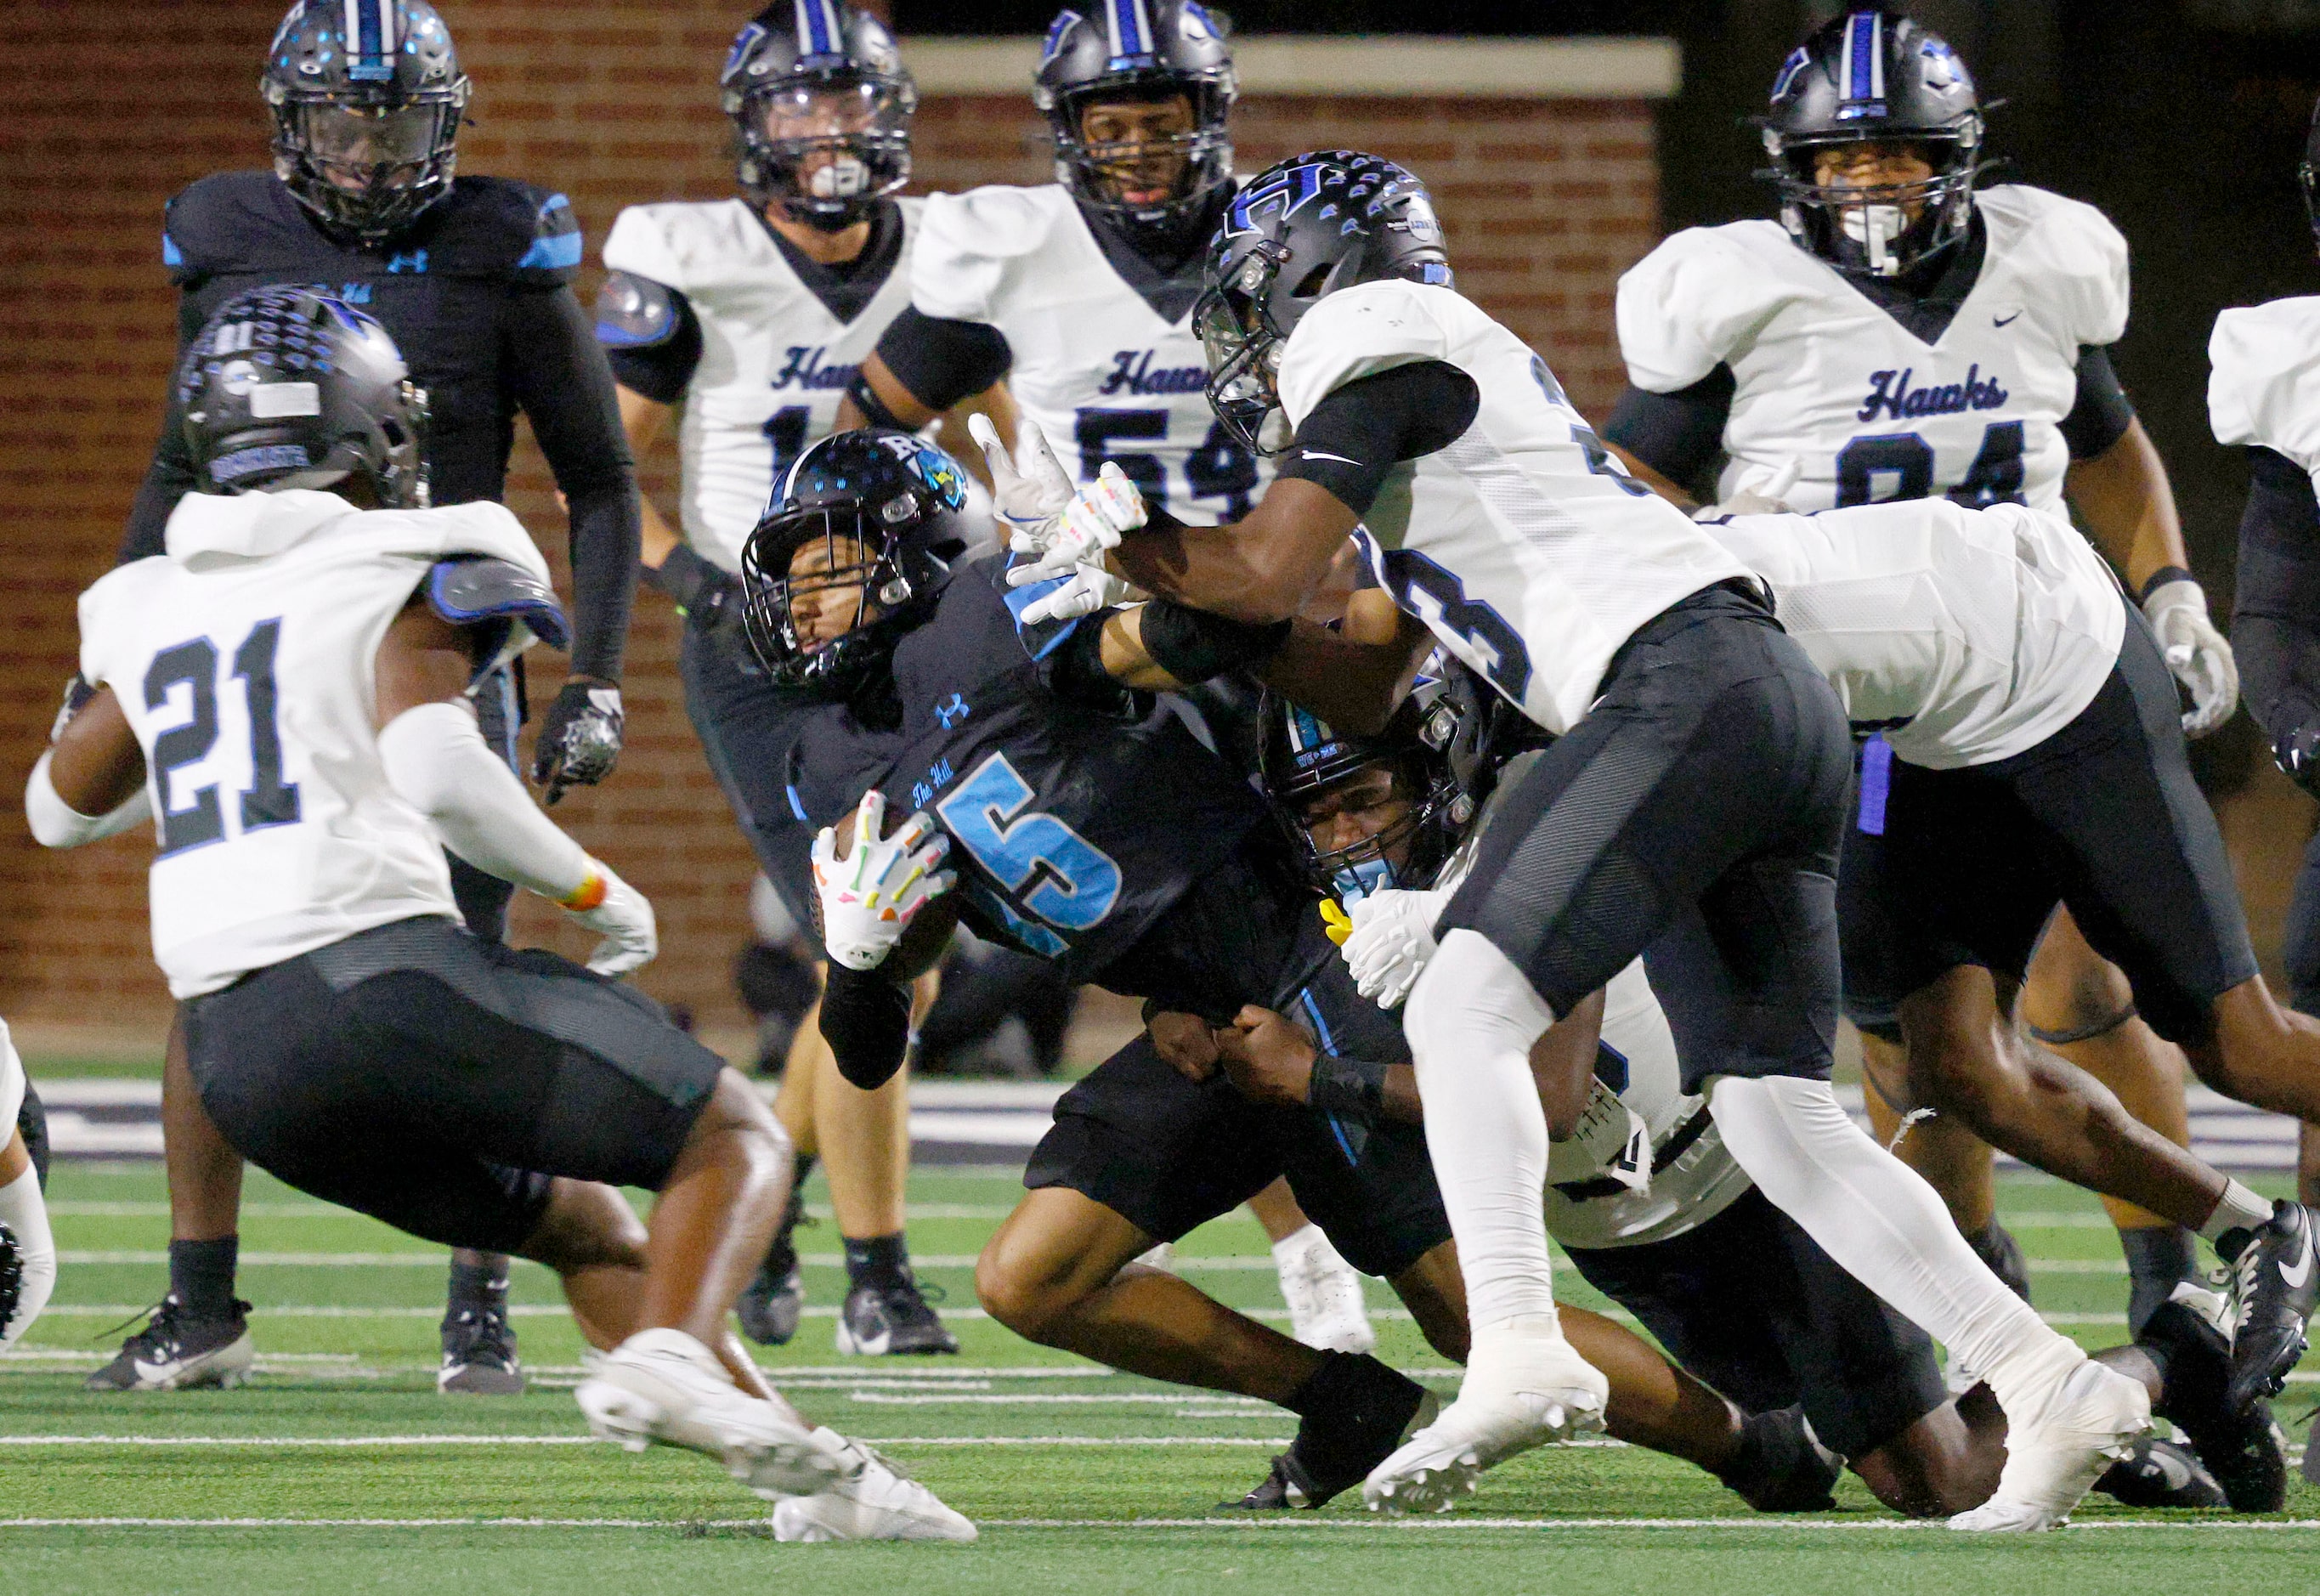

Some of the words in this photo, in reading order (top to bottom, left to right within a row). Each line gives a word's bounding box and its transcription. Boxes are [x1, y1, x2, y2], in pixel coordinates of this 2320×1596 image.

[1856, 363, 2009, 422] Hawks
[1074, 407, 1261, 524] 54
[142, 615, 303, 862] 21
[912, 781, 933, 810] The
